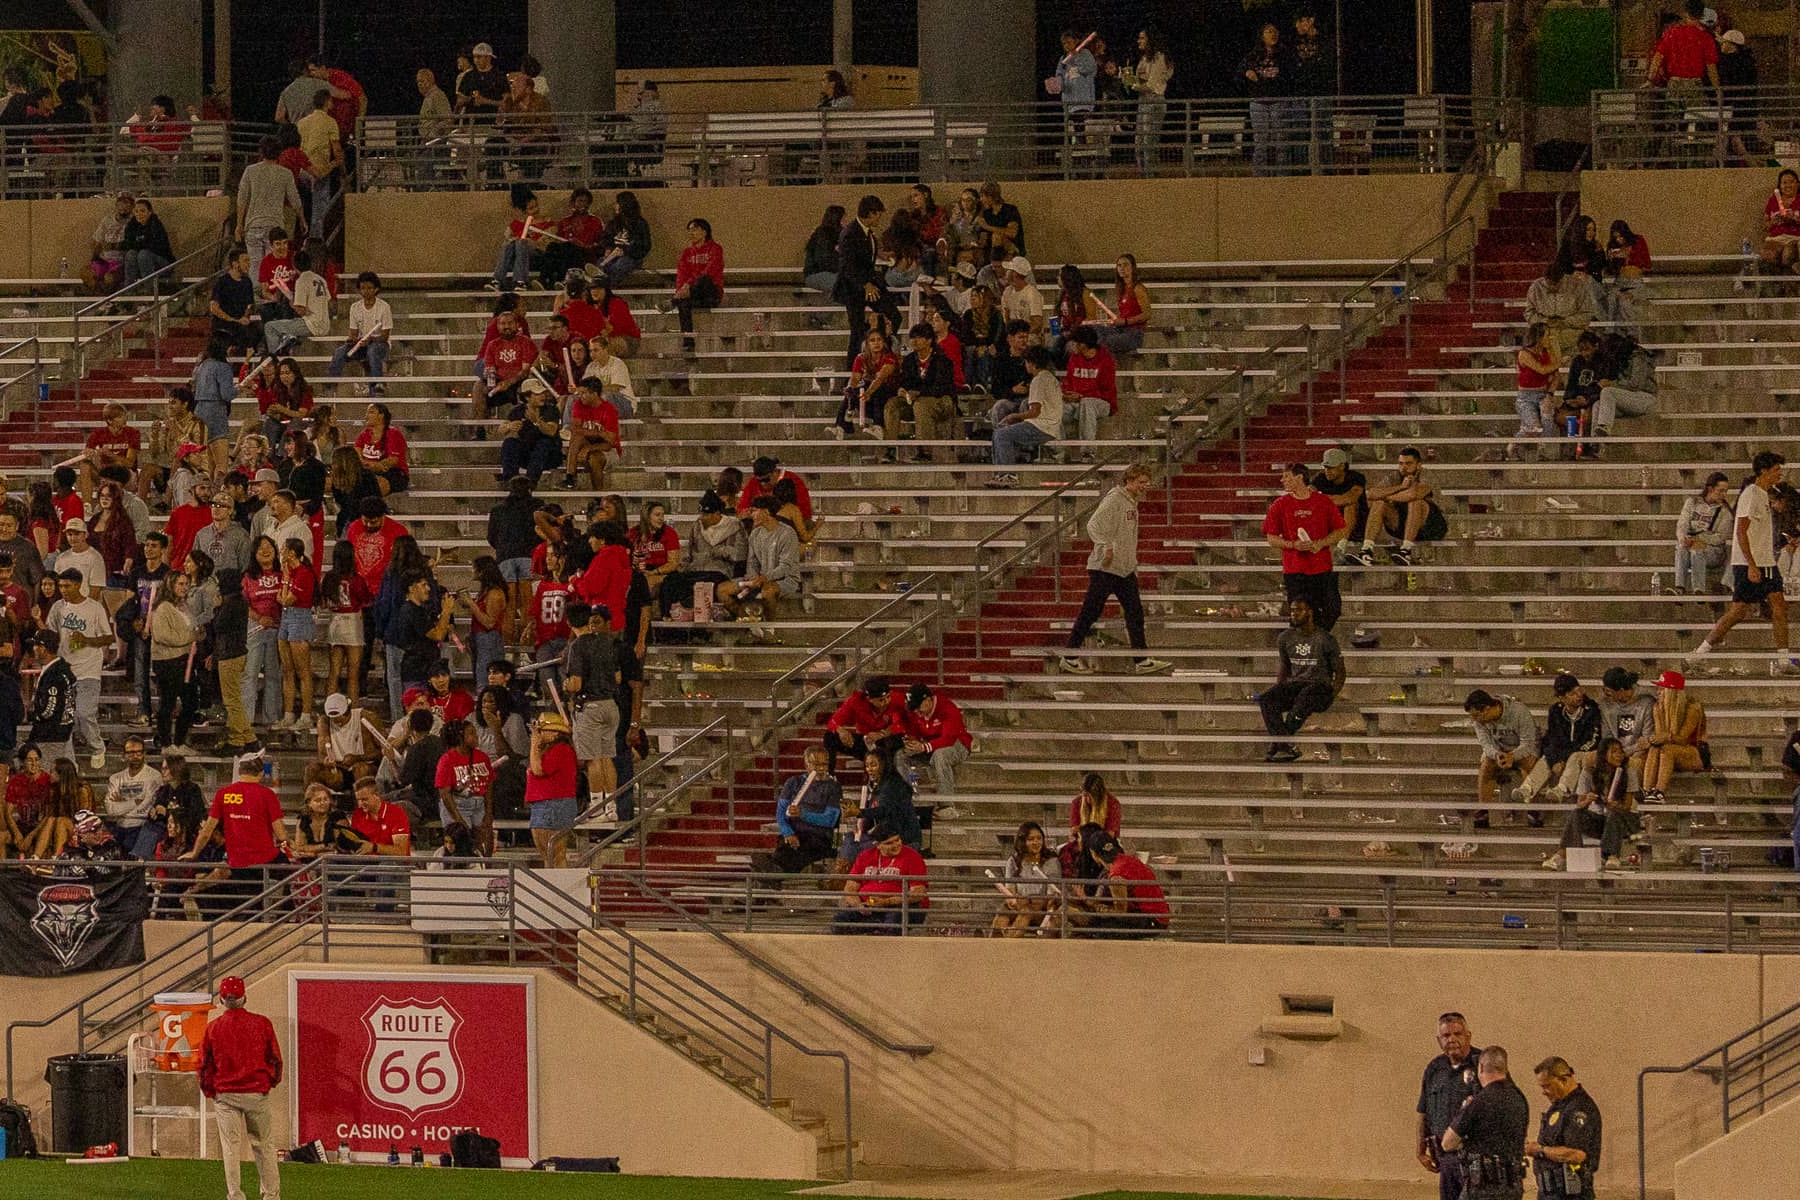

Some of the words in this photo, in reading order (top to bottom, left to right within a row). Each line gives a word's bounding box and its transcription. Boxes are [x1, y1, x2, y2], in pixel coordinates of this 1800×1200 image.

[224, 793, 244, 804] 505
[164, 1014, 182, 1039] G
[382, 1015, 443, 1033] ROUTE
[380, 1050, 446, 1094] 66
[336, 1124, 405, 1140] CASINO
